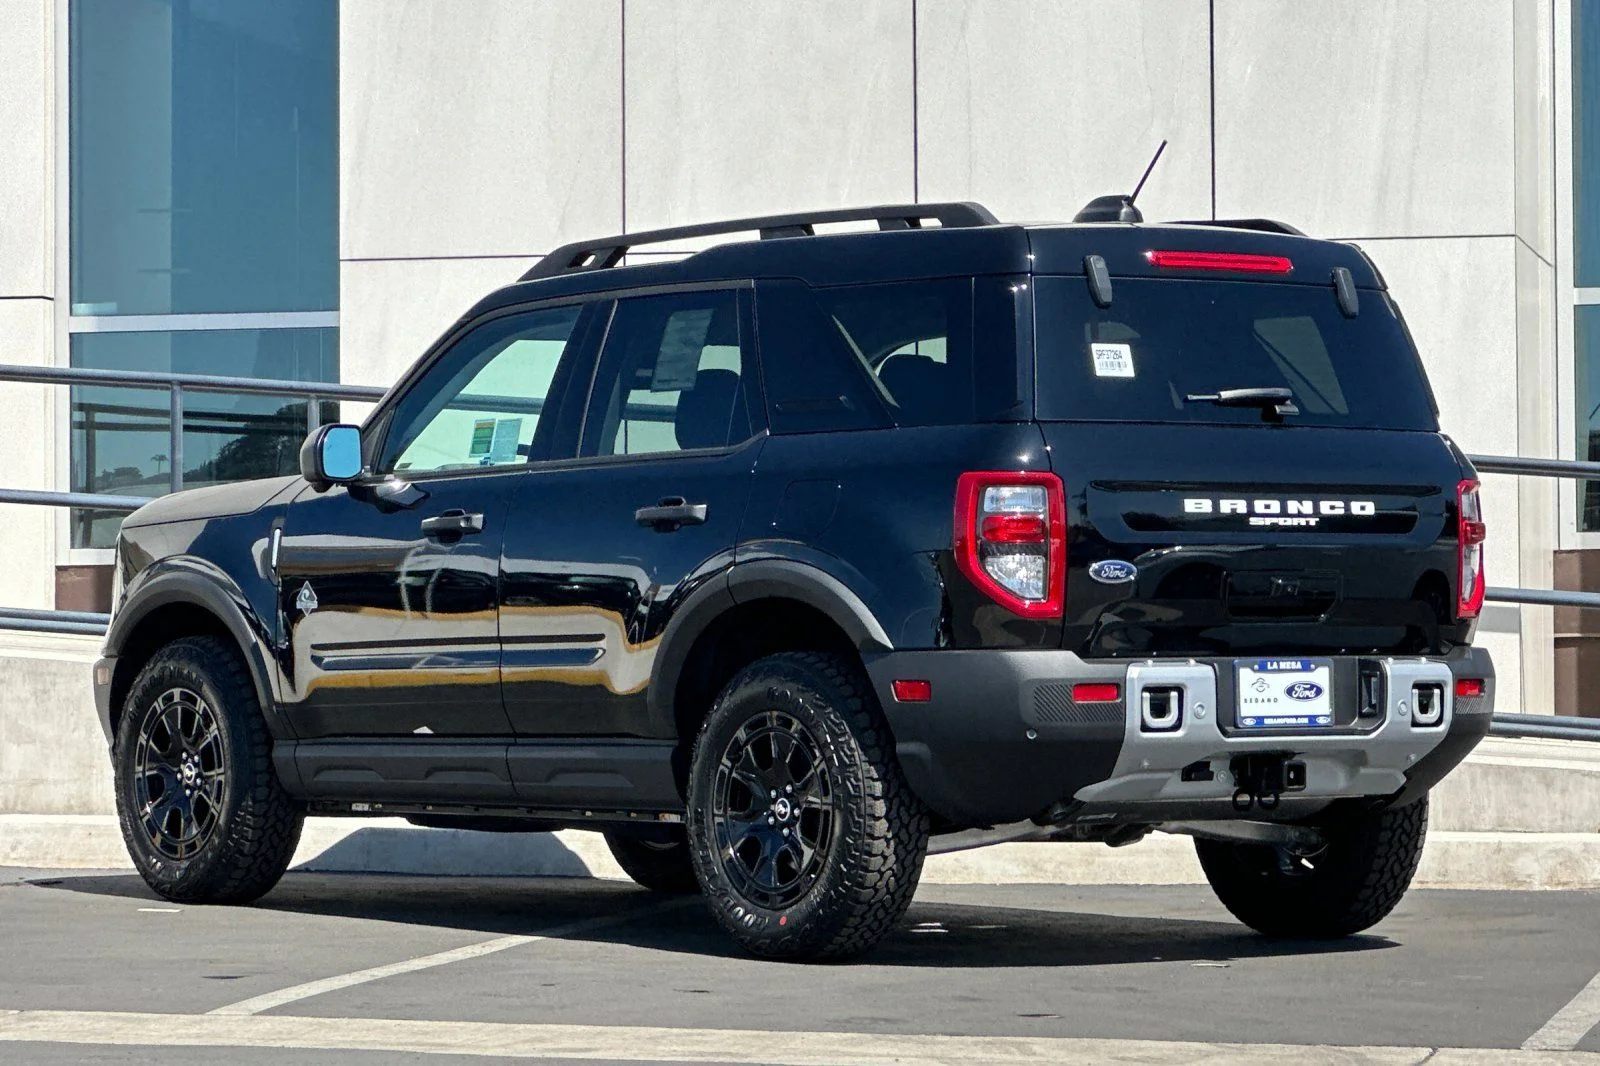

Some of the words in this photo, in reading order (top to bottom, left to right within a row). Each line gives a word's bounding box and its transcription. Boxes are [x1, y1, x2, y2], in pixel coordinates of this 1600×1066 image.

[1184, 498, 1375, 515] BRONCO
[1249, 517, 1319, 526] SPORT
[1267, 661, 1278, 670] LA
[1280, 661, 1302, 670] MESA
[1291, 683, 1317, 698] Ford
